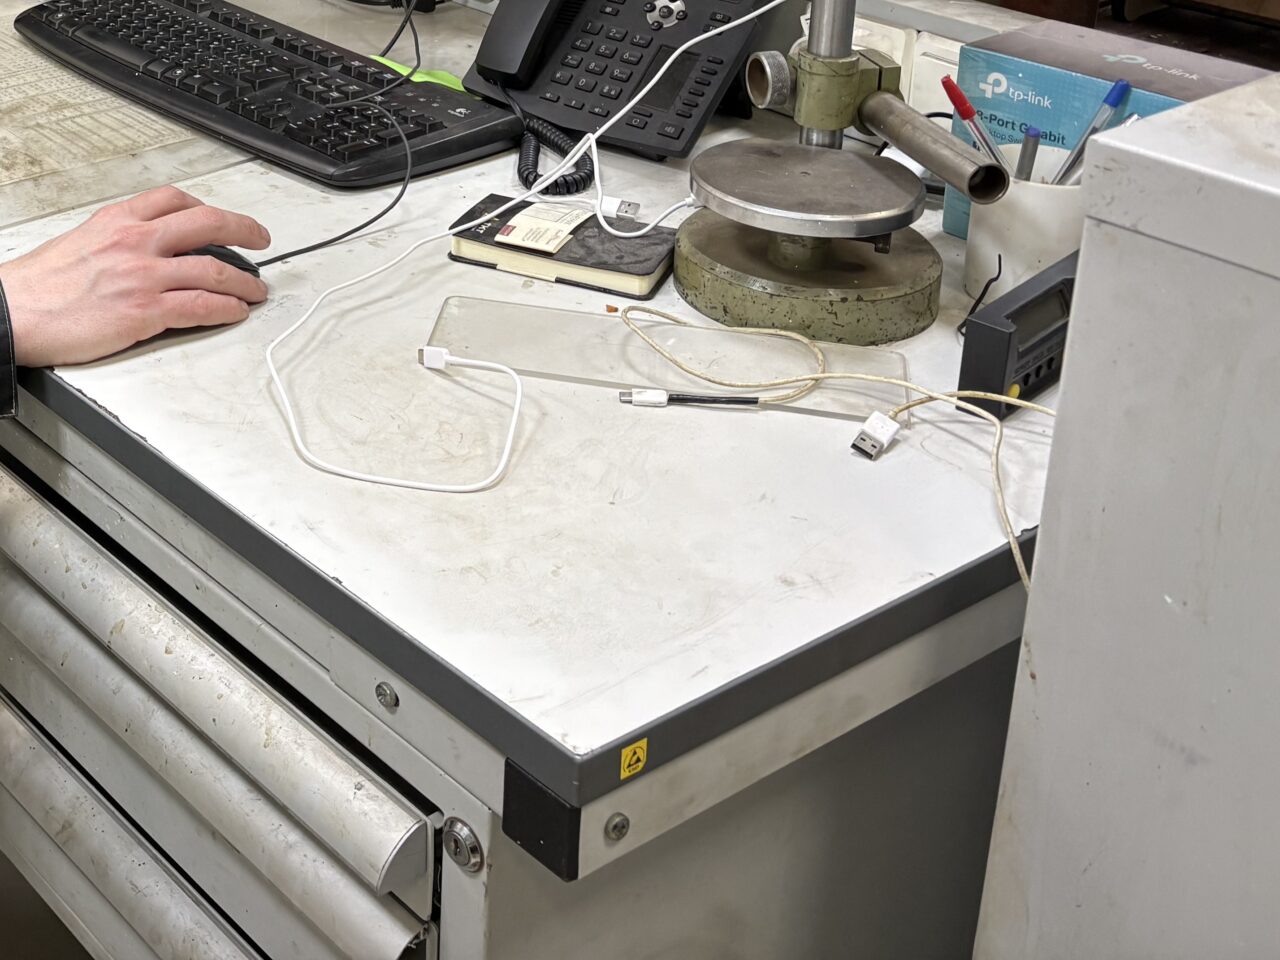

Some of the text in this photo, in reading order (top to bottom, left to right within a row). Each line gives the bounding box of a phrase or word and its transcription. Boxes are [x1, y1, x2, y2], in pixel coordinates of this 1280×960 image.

[1142, 62, 1201, 81] tp-link
[1009, 87, 1052, 109] tp-link
[1019, 122, 1066, 146] Gabit
